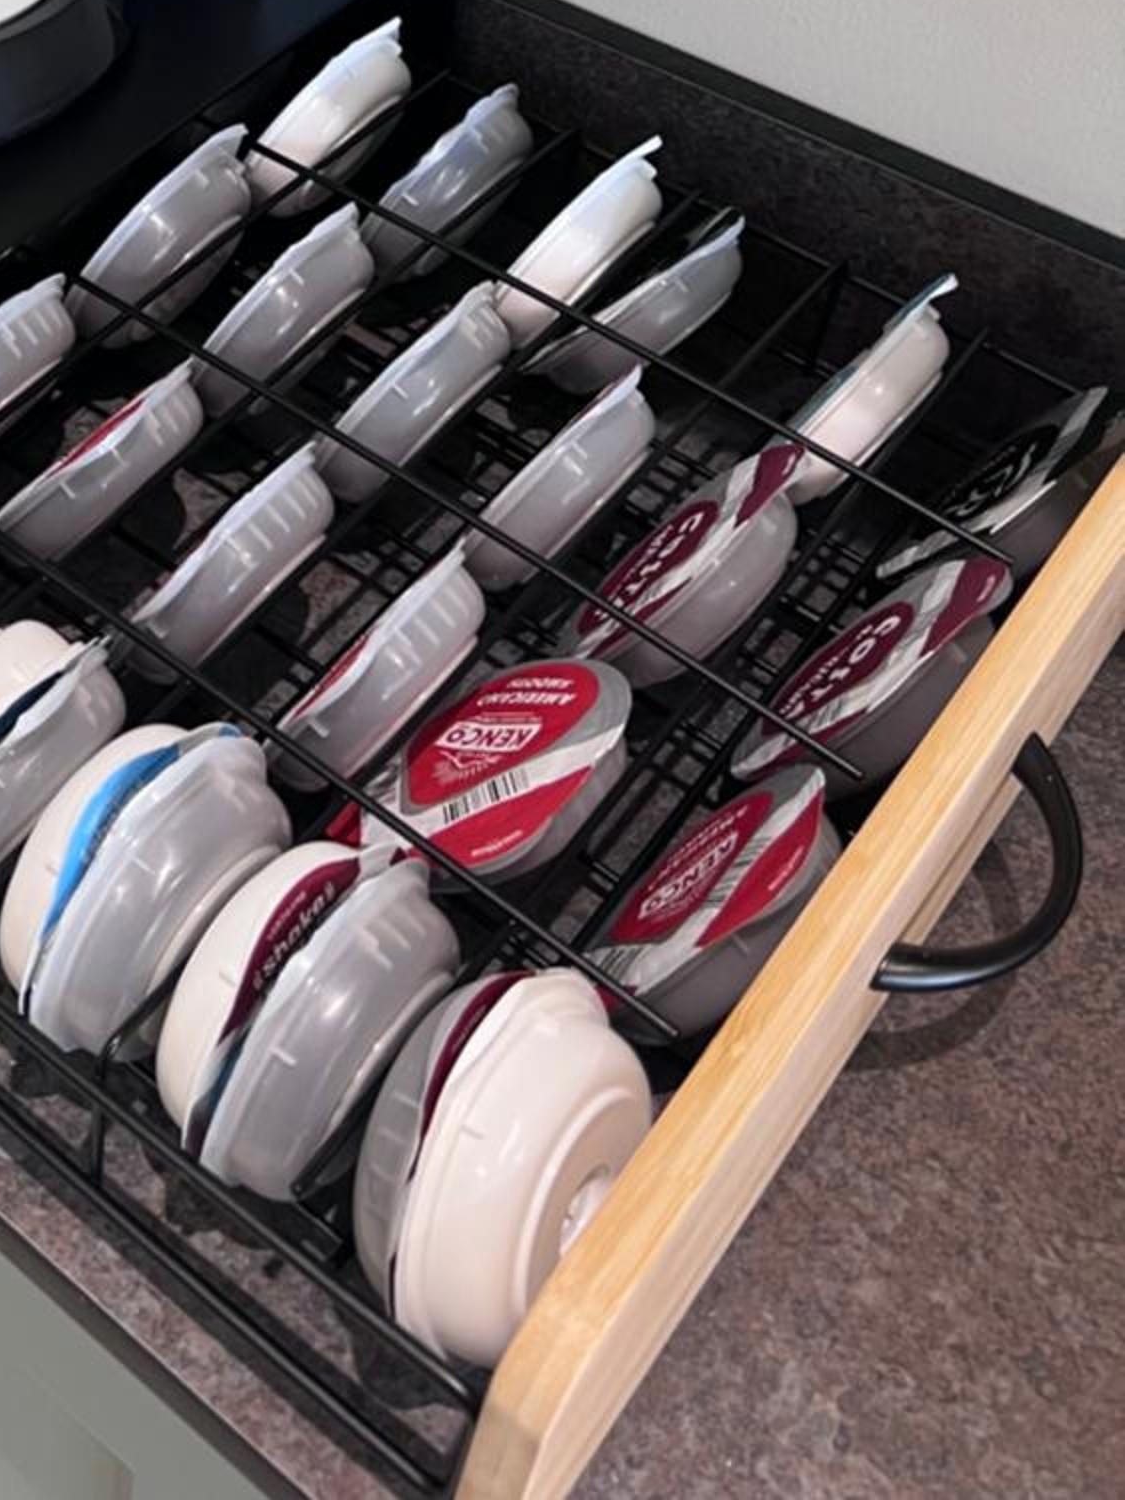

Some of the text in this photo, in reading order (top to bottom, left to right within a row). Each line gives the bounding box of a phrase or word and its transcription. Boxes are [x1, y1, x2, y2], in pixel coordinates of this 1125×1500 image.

[784, 615, 903, 720] COSTA
[446, 727, 533, 748] KENCO
[644, 836, 734, 913] KENCO
